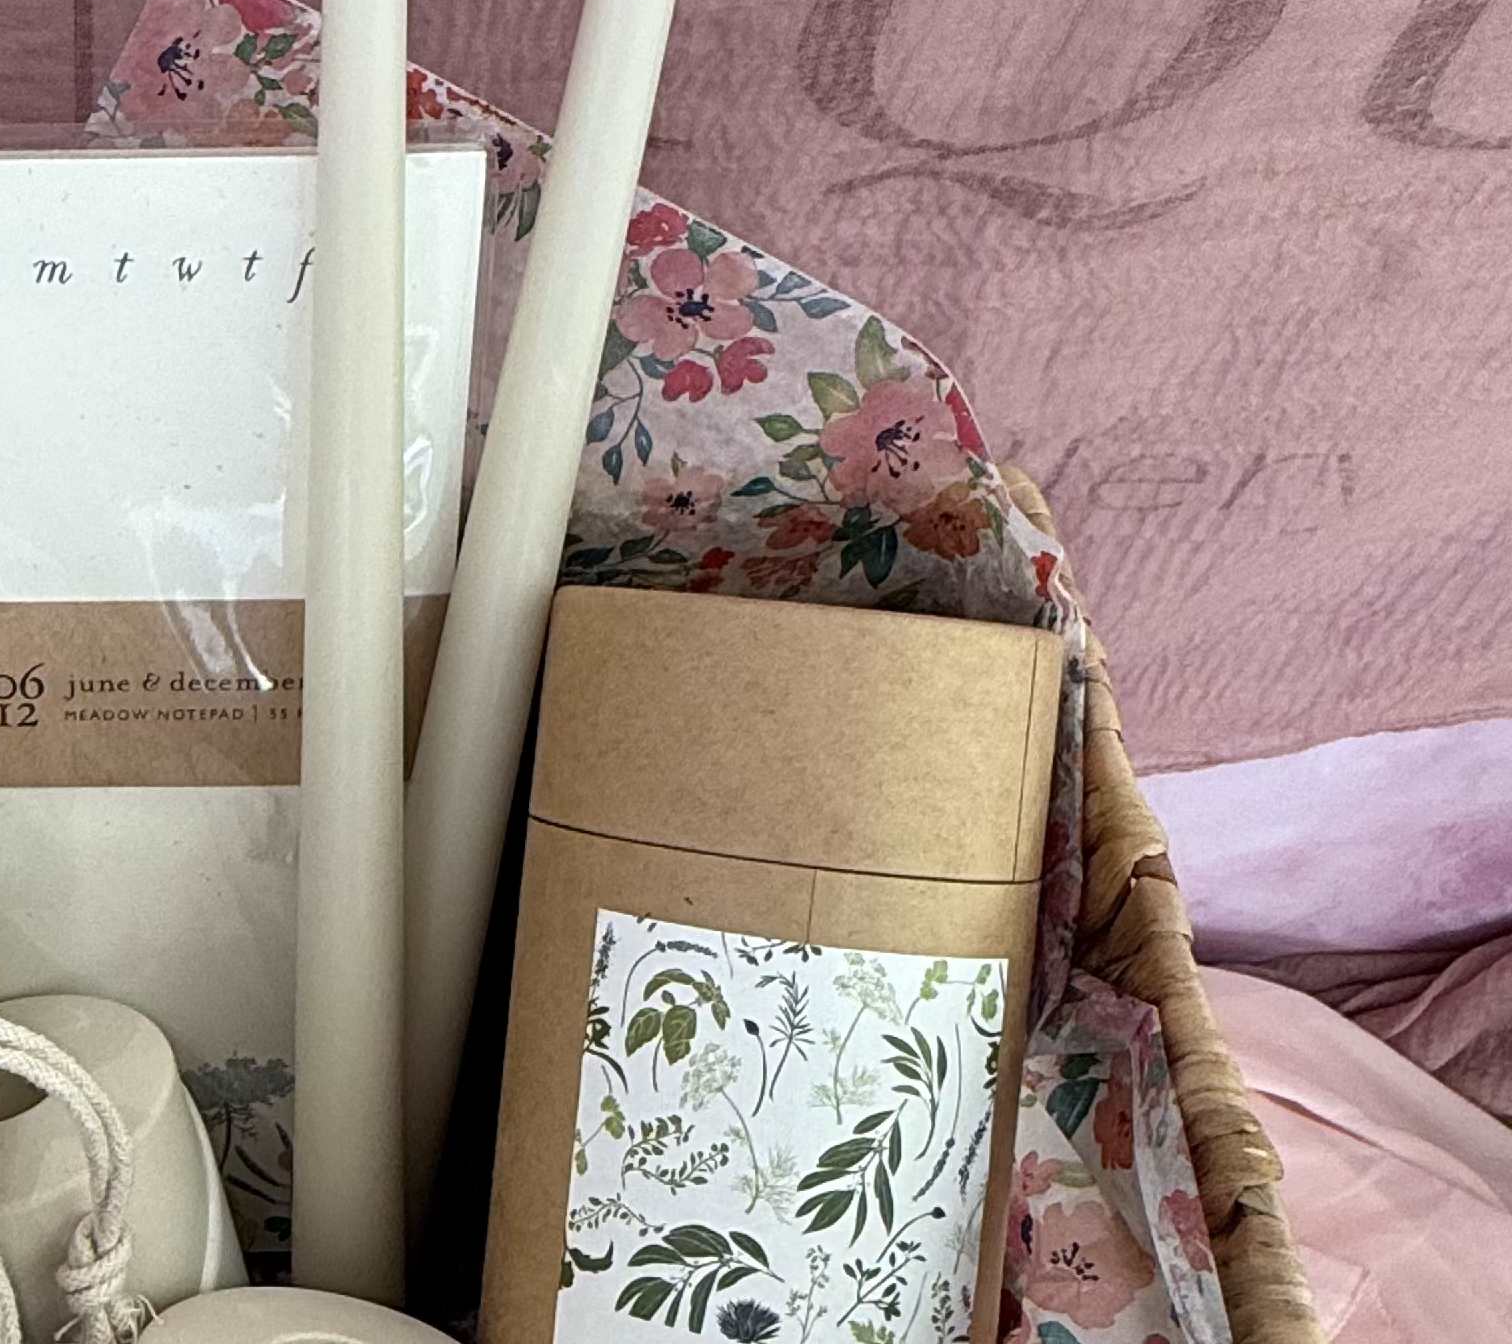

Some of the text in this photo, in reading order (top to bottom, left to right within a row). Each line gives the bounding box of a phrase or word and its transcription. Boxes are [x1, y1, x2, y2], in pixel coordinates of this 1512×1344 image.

[33, 258, 72, 284] m
[114, 252, 134, 284] t
[173, 256, 202, 283] w
[244, 251, 262, 282] t
[63, 675, 130, 701] june
[142, 673, 161, 692] &
[64, 708, 148, 721] MEADOW
[157, 708, 244, 721] NOTEPAD
